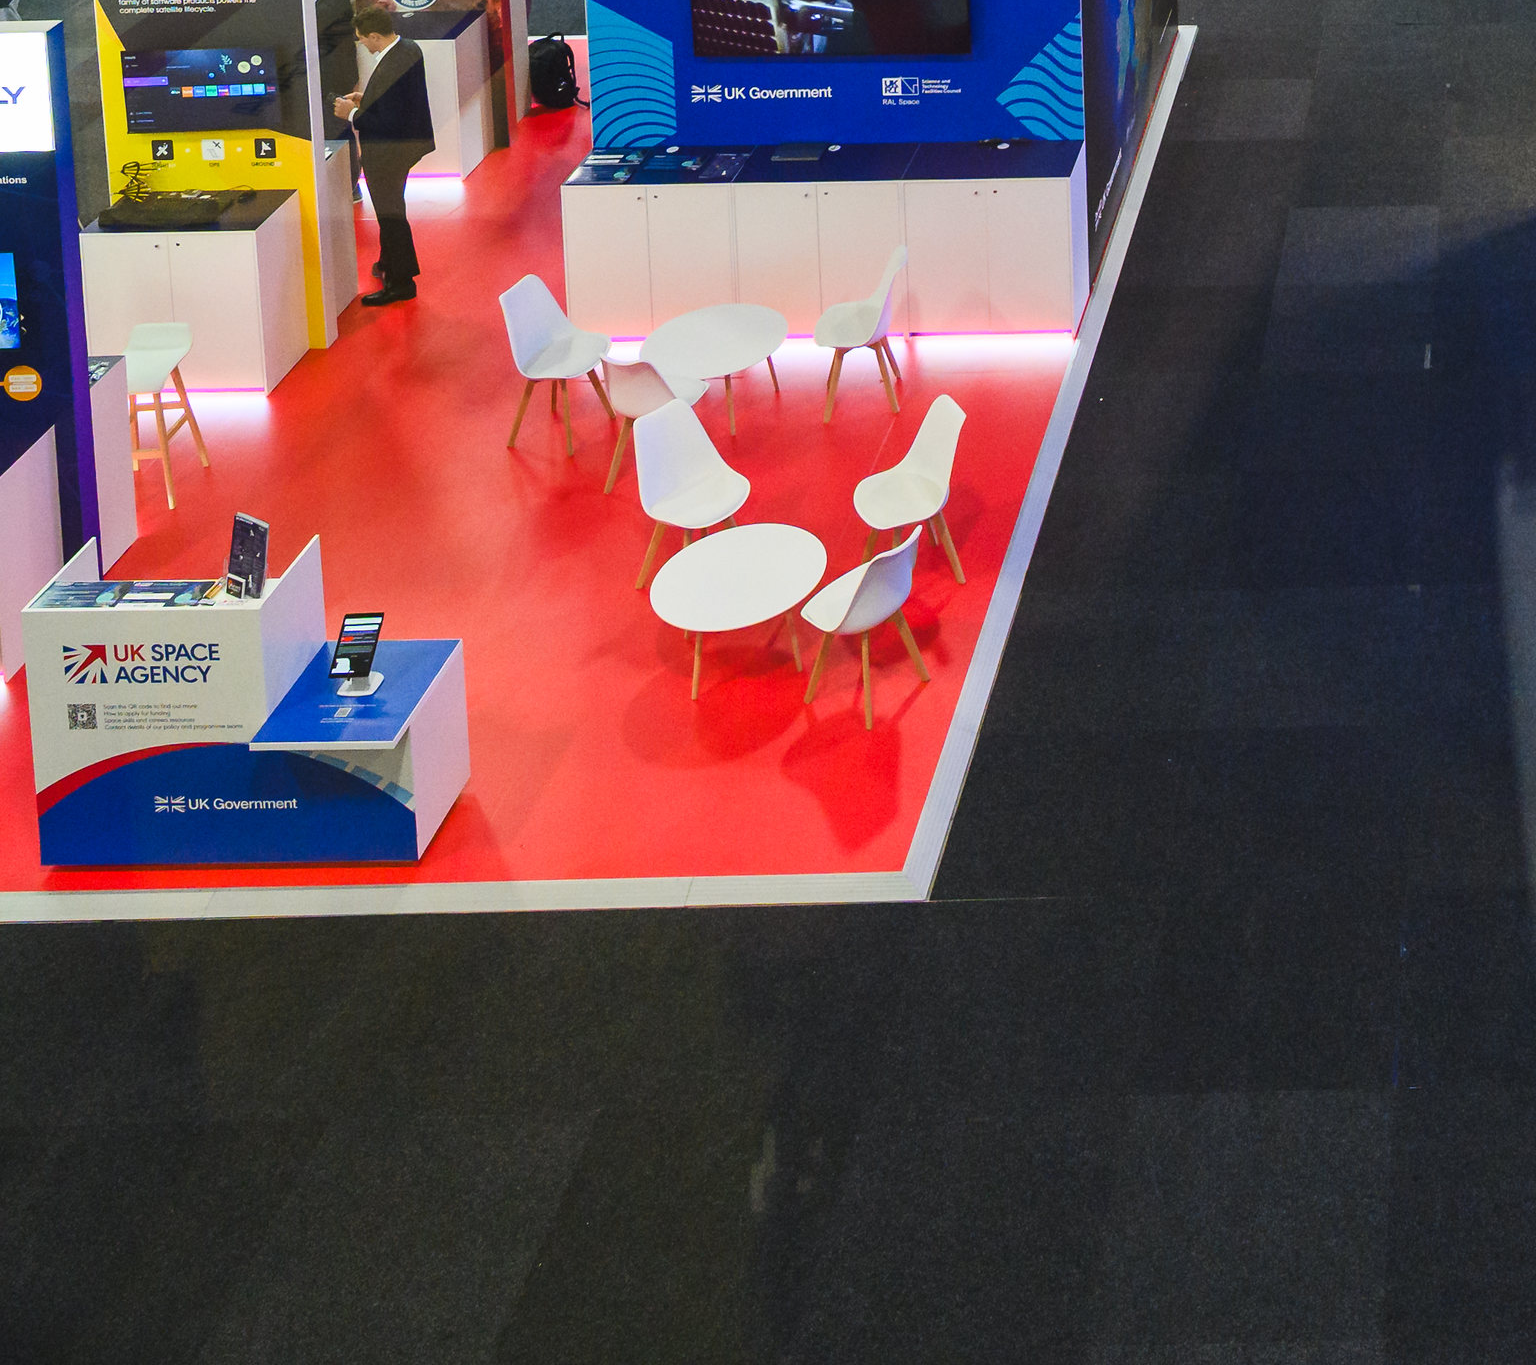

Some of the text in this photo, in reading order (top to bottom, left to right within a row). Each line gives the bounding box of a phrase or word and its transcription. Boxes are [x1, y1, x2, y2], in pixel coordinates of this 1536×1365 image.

[724, 85, 832, 100] UK Government
[898, 98, 920, 106] Space
[114, 643, 220, 662] UK SPACE
[115, 666, 211, 683] AGENCY
[189, 798, 297, 810] UK Government
